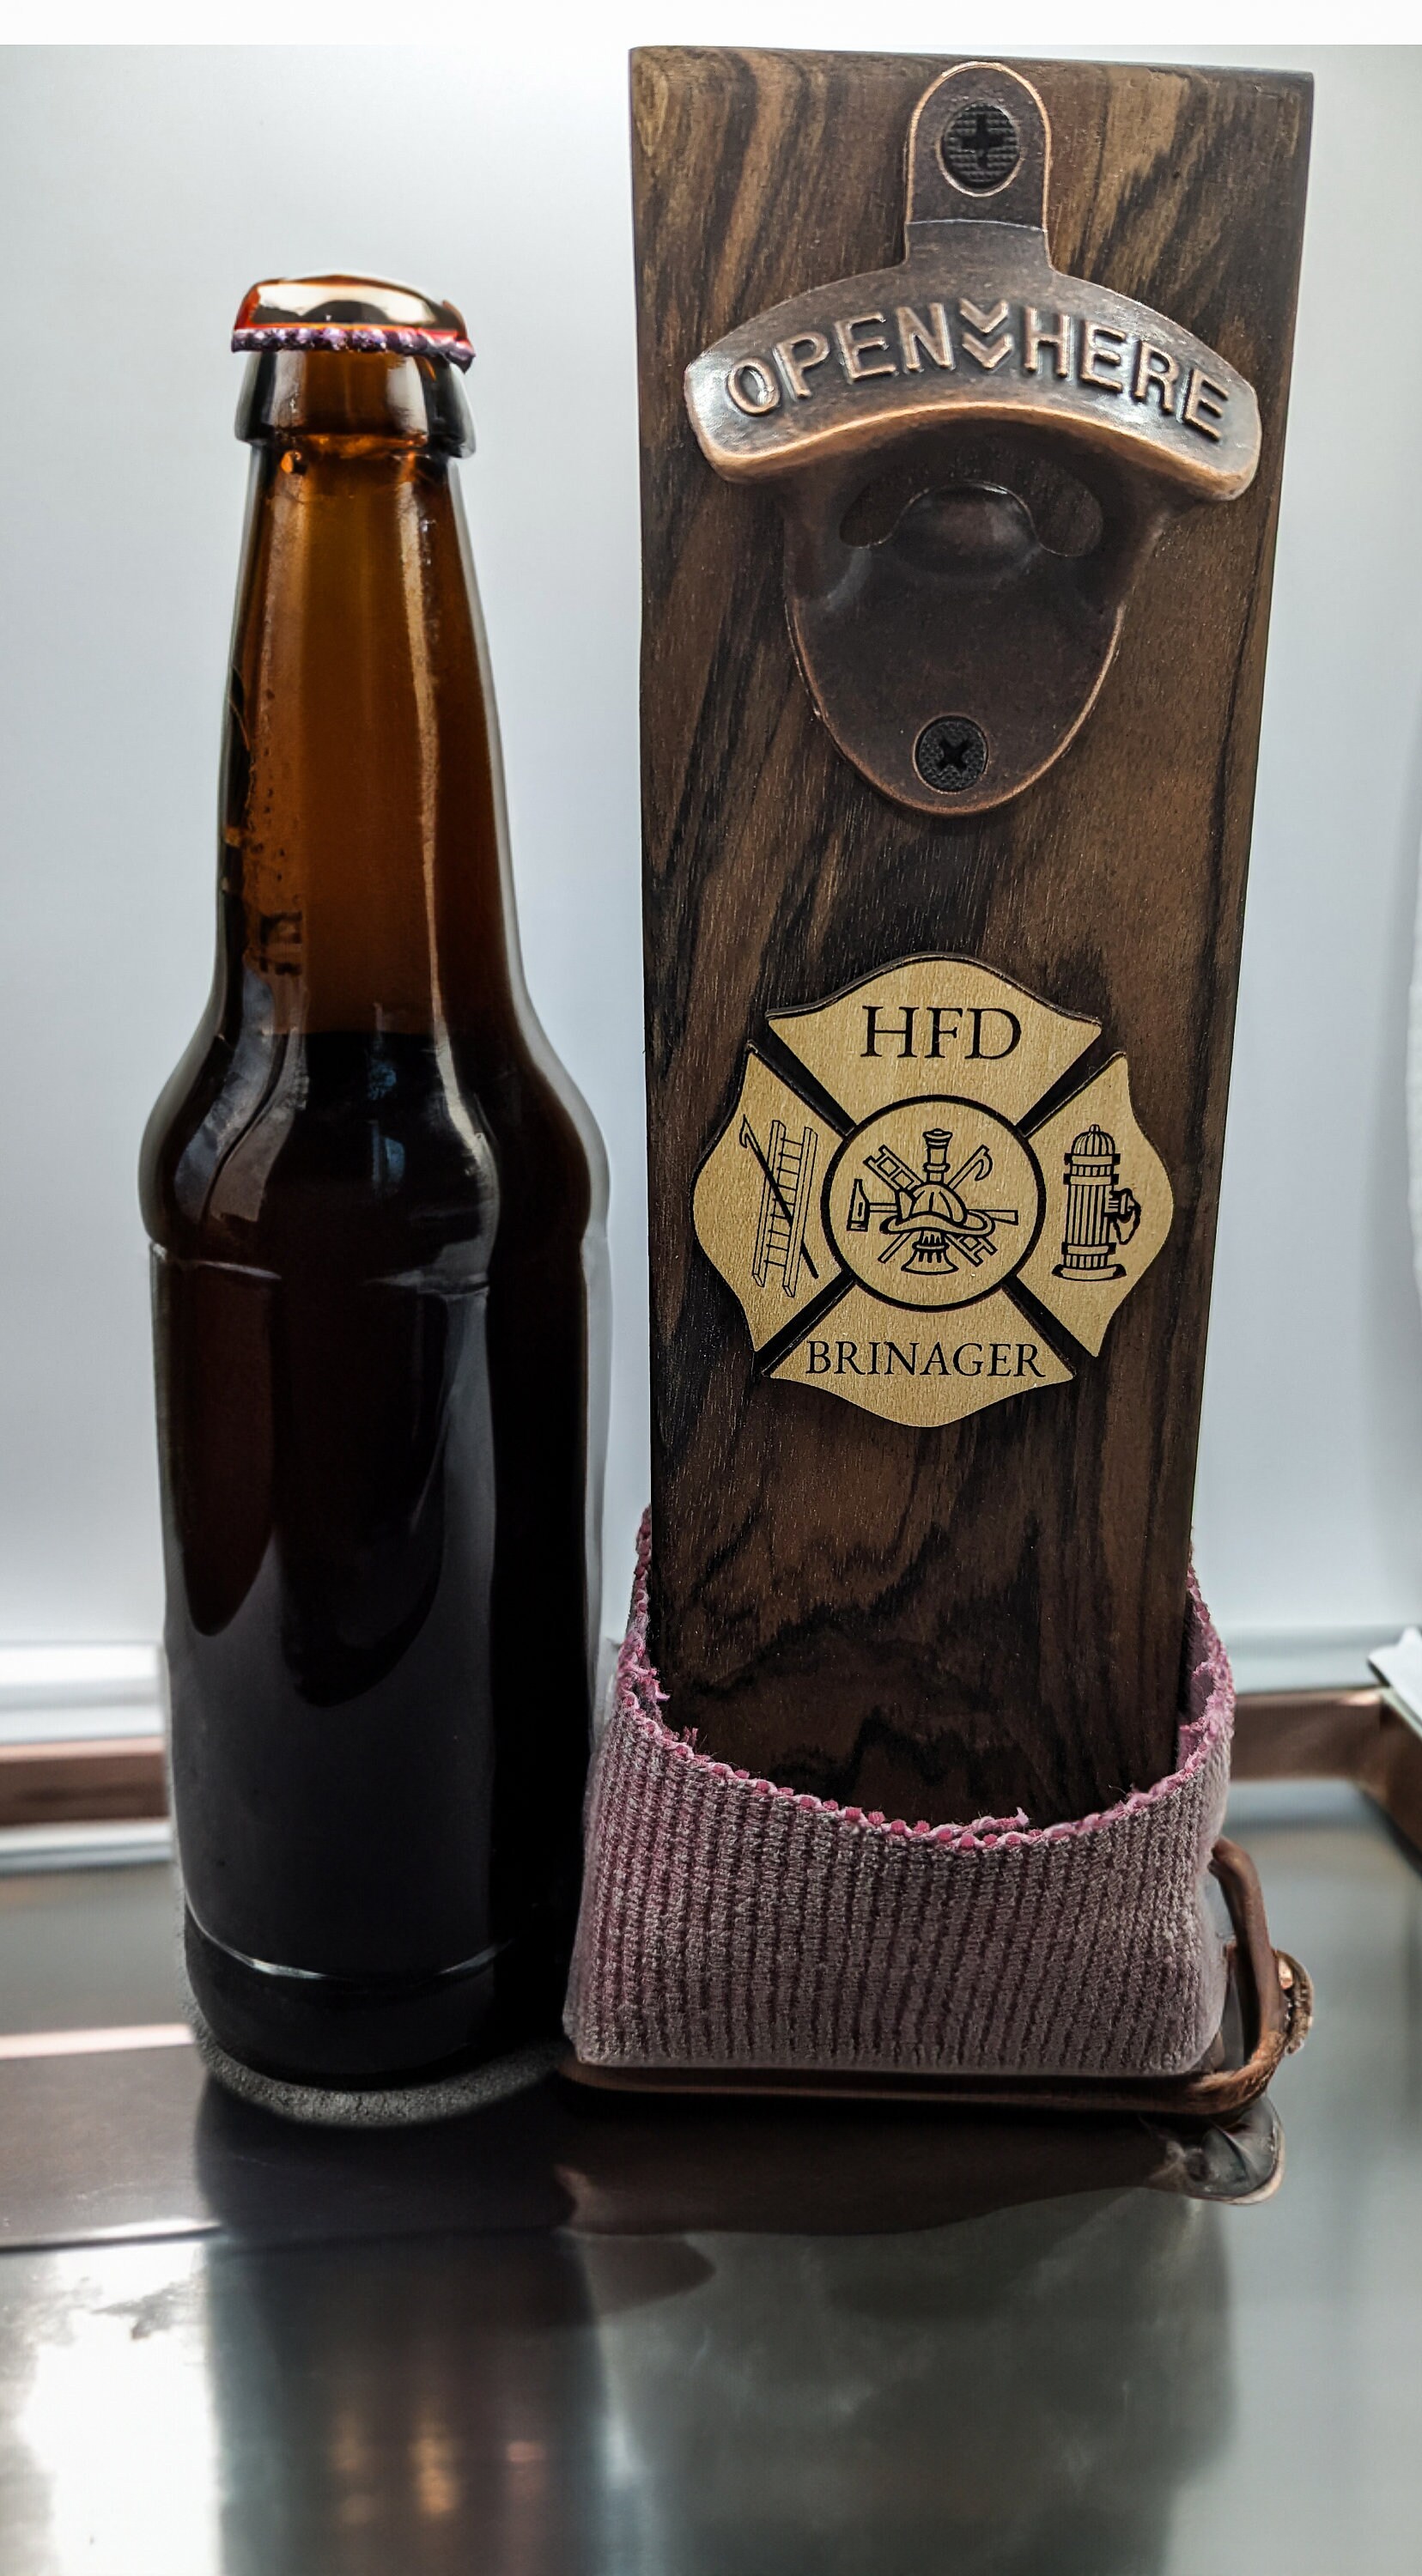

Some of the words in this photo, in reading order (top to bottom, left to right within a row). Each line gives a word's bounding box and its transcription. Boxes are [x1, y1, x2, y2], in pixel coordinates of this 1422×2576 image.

[726, 302, 953, 416] OPEN
[1023, 307, 1229, 440] HERE
[860, 1005, 1022, 1060] HFD
[805, 1340, 1046, 1377] BRINAGER
